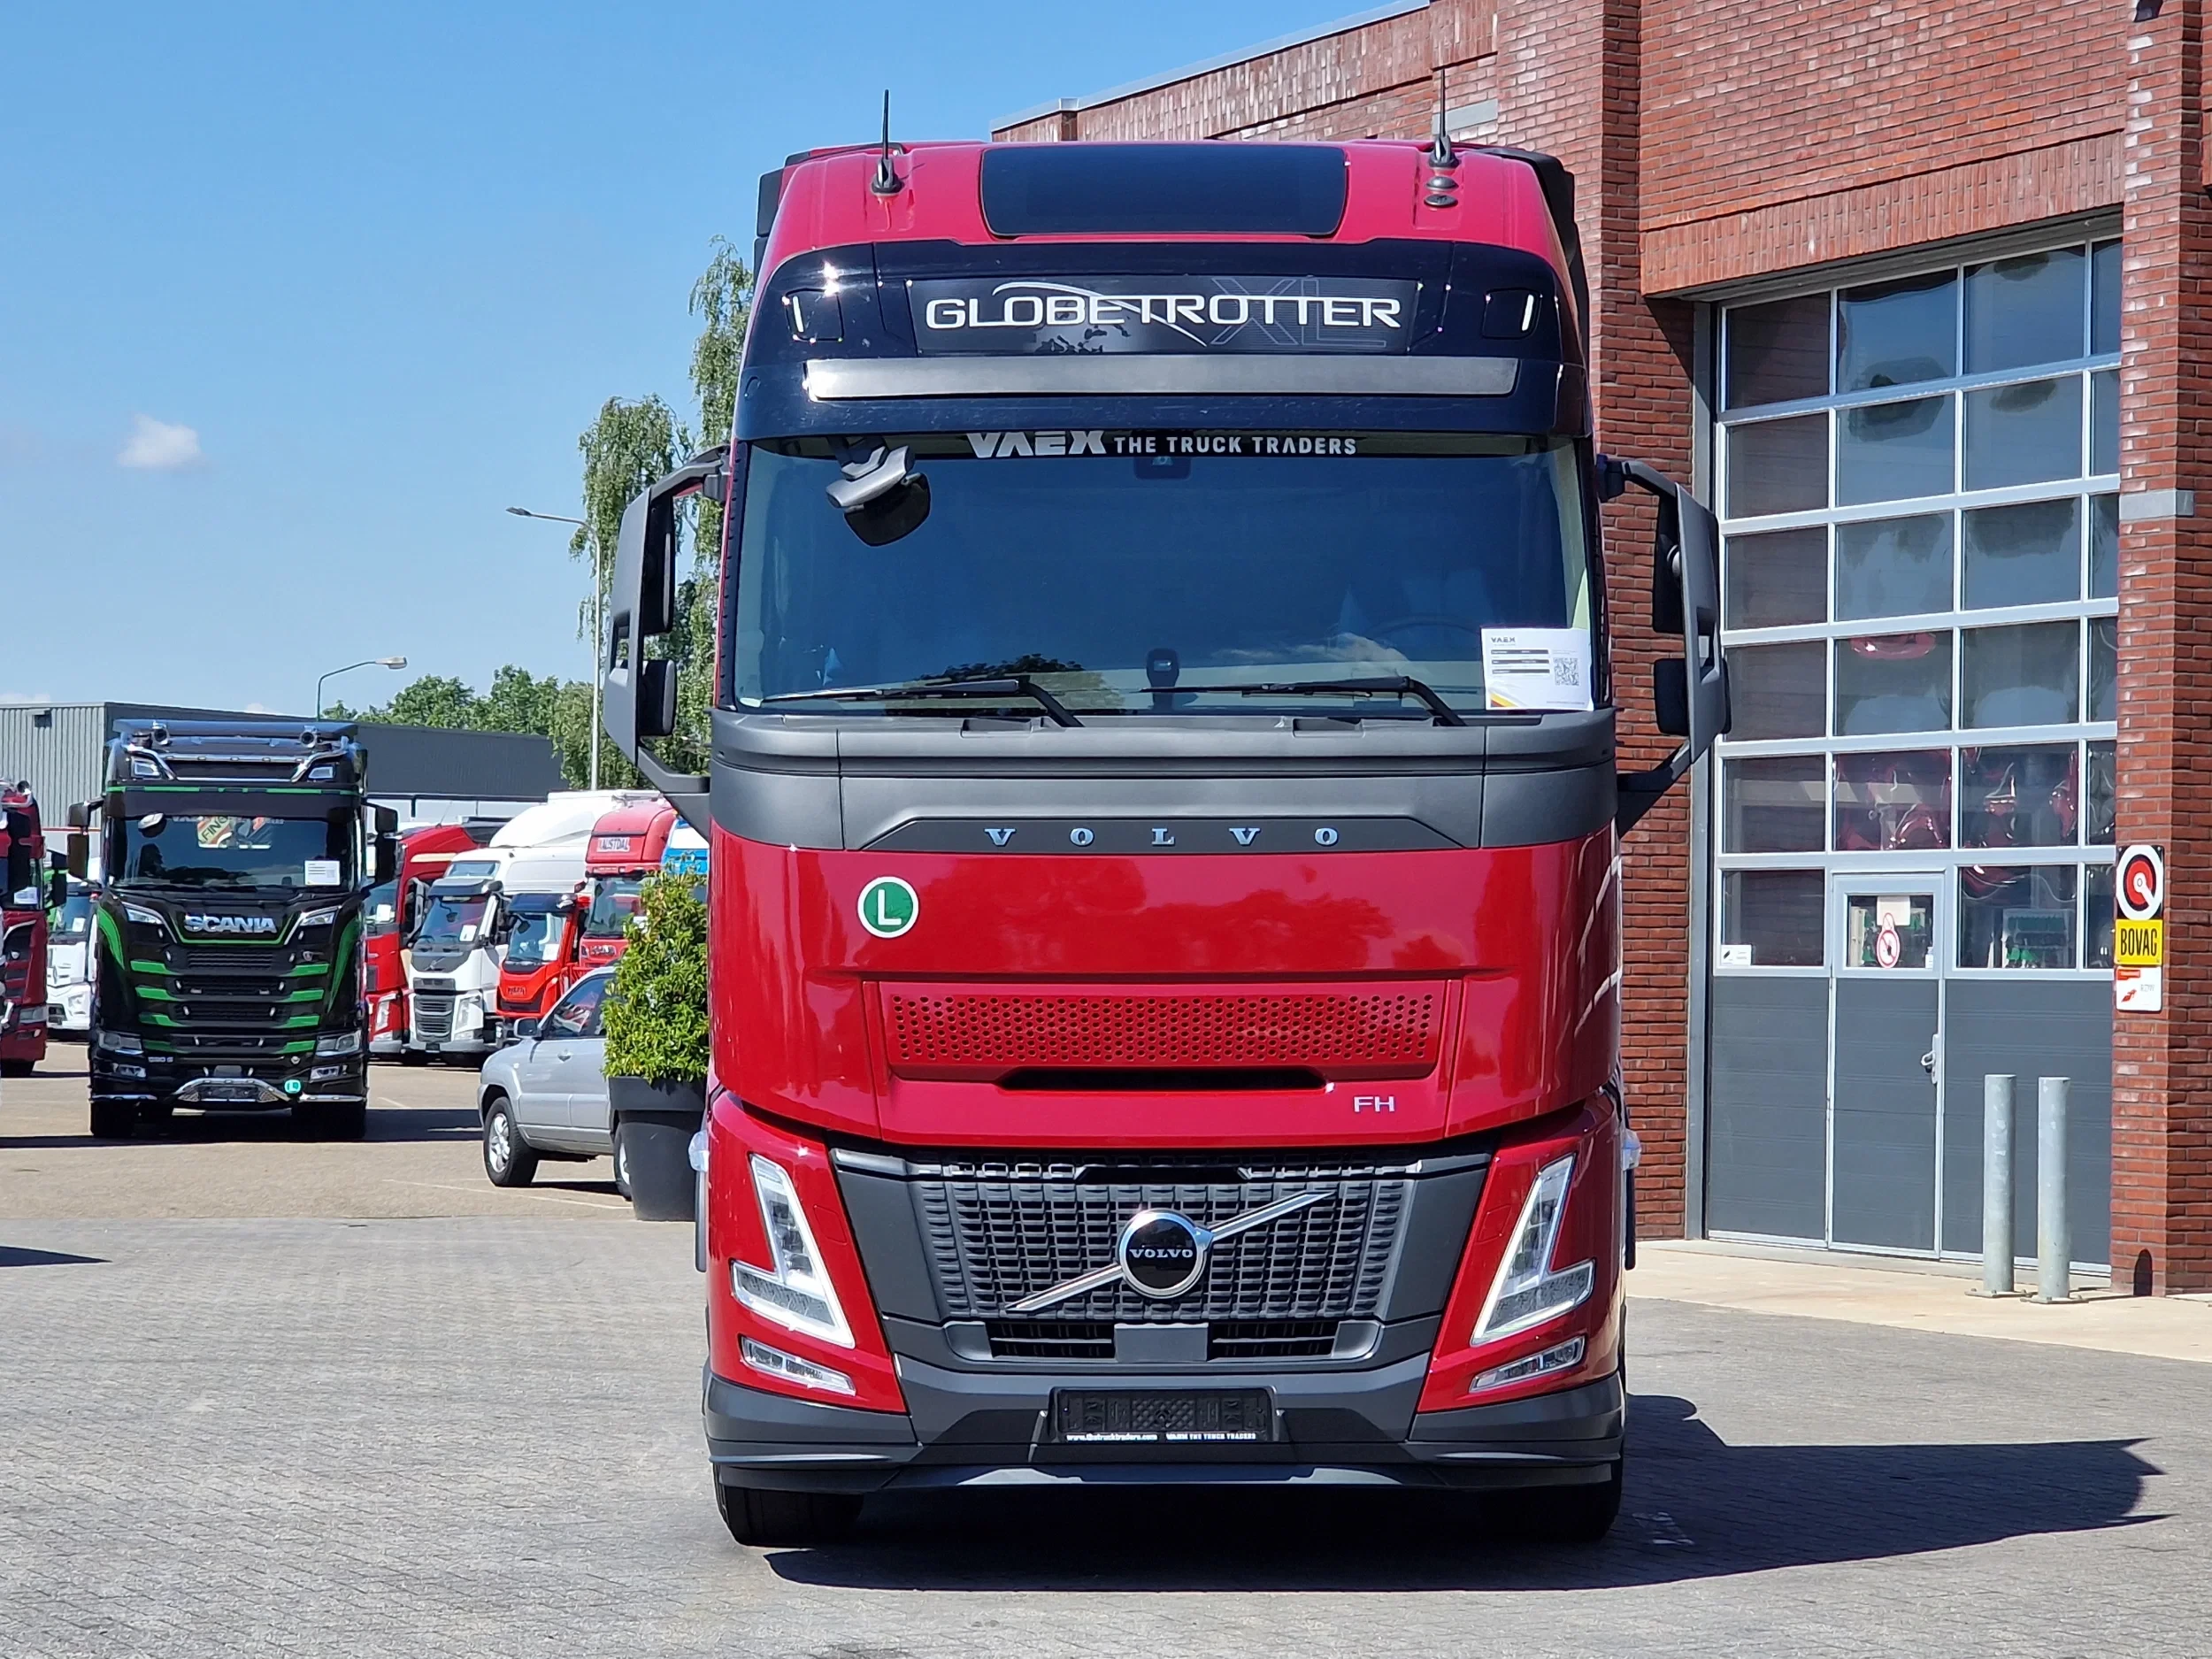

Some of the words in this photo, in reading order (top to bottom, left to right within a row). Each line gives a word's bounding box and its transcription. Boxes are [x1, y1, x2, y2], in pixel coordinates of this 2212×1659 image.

[926, 295, 1402, 329] GLOBETROTTER
[966, 430, 1107, 458] VAEX
[1114, 436, 1156, 454] THE
[1166, 436, 1242, 454] TRUCK
[1251, 436, 1357, 455] TRADERS
[984, 827, 1339, 847] VOLVO
[877, 889, 902, 926] L
[184, 912, 278, 933] SCANIA
[2120, 928, 2158, 956] BOVAG
[1353, 1096, 1395, 1112] FH
[1129, 1248, 1194, 1258] VOLVO
